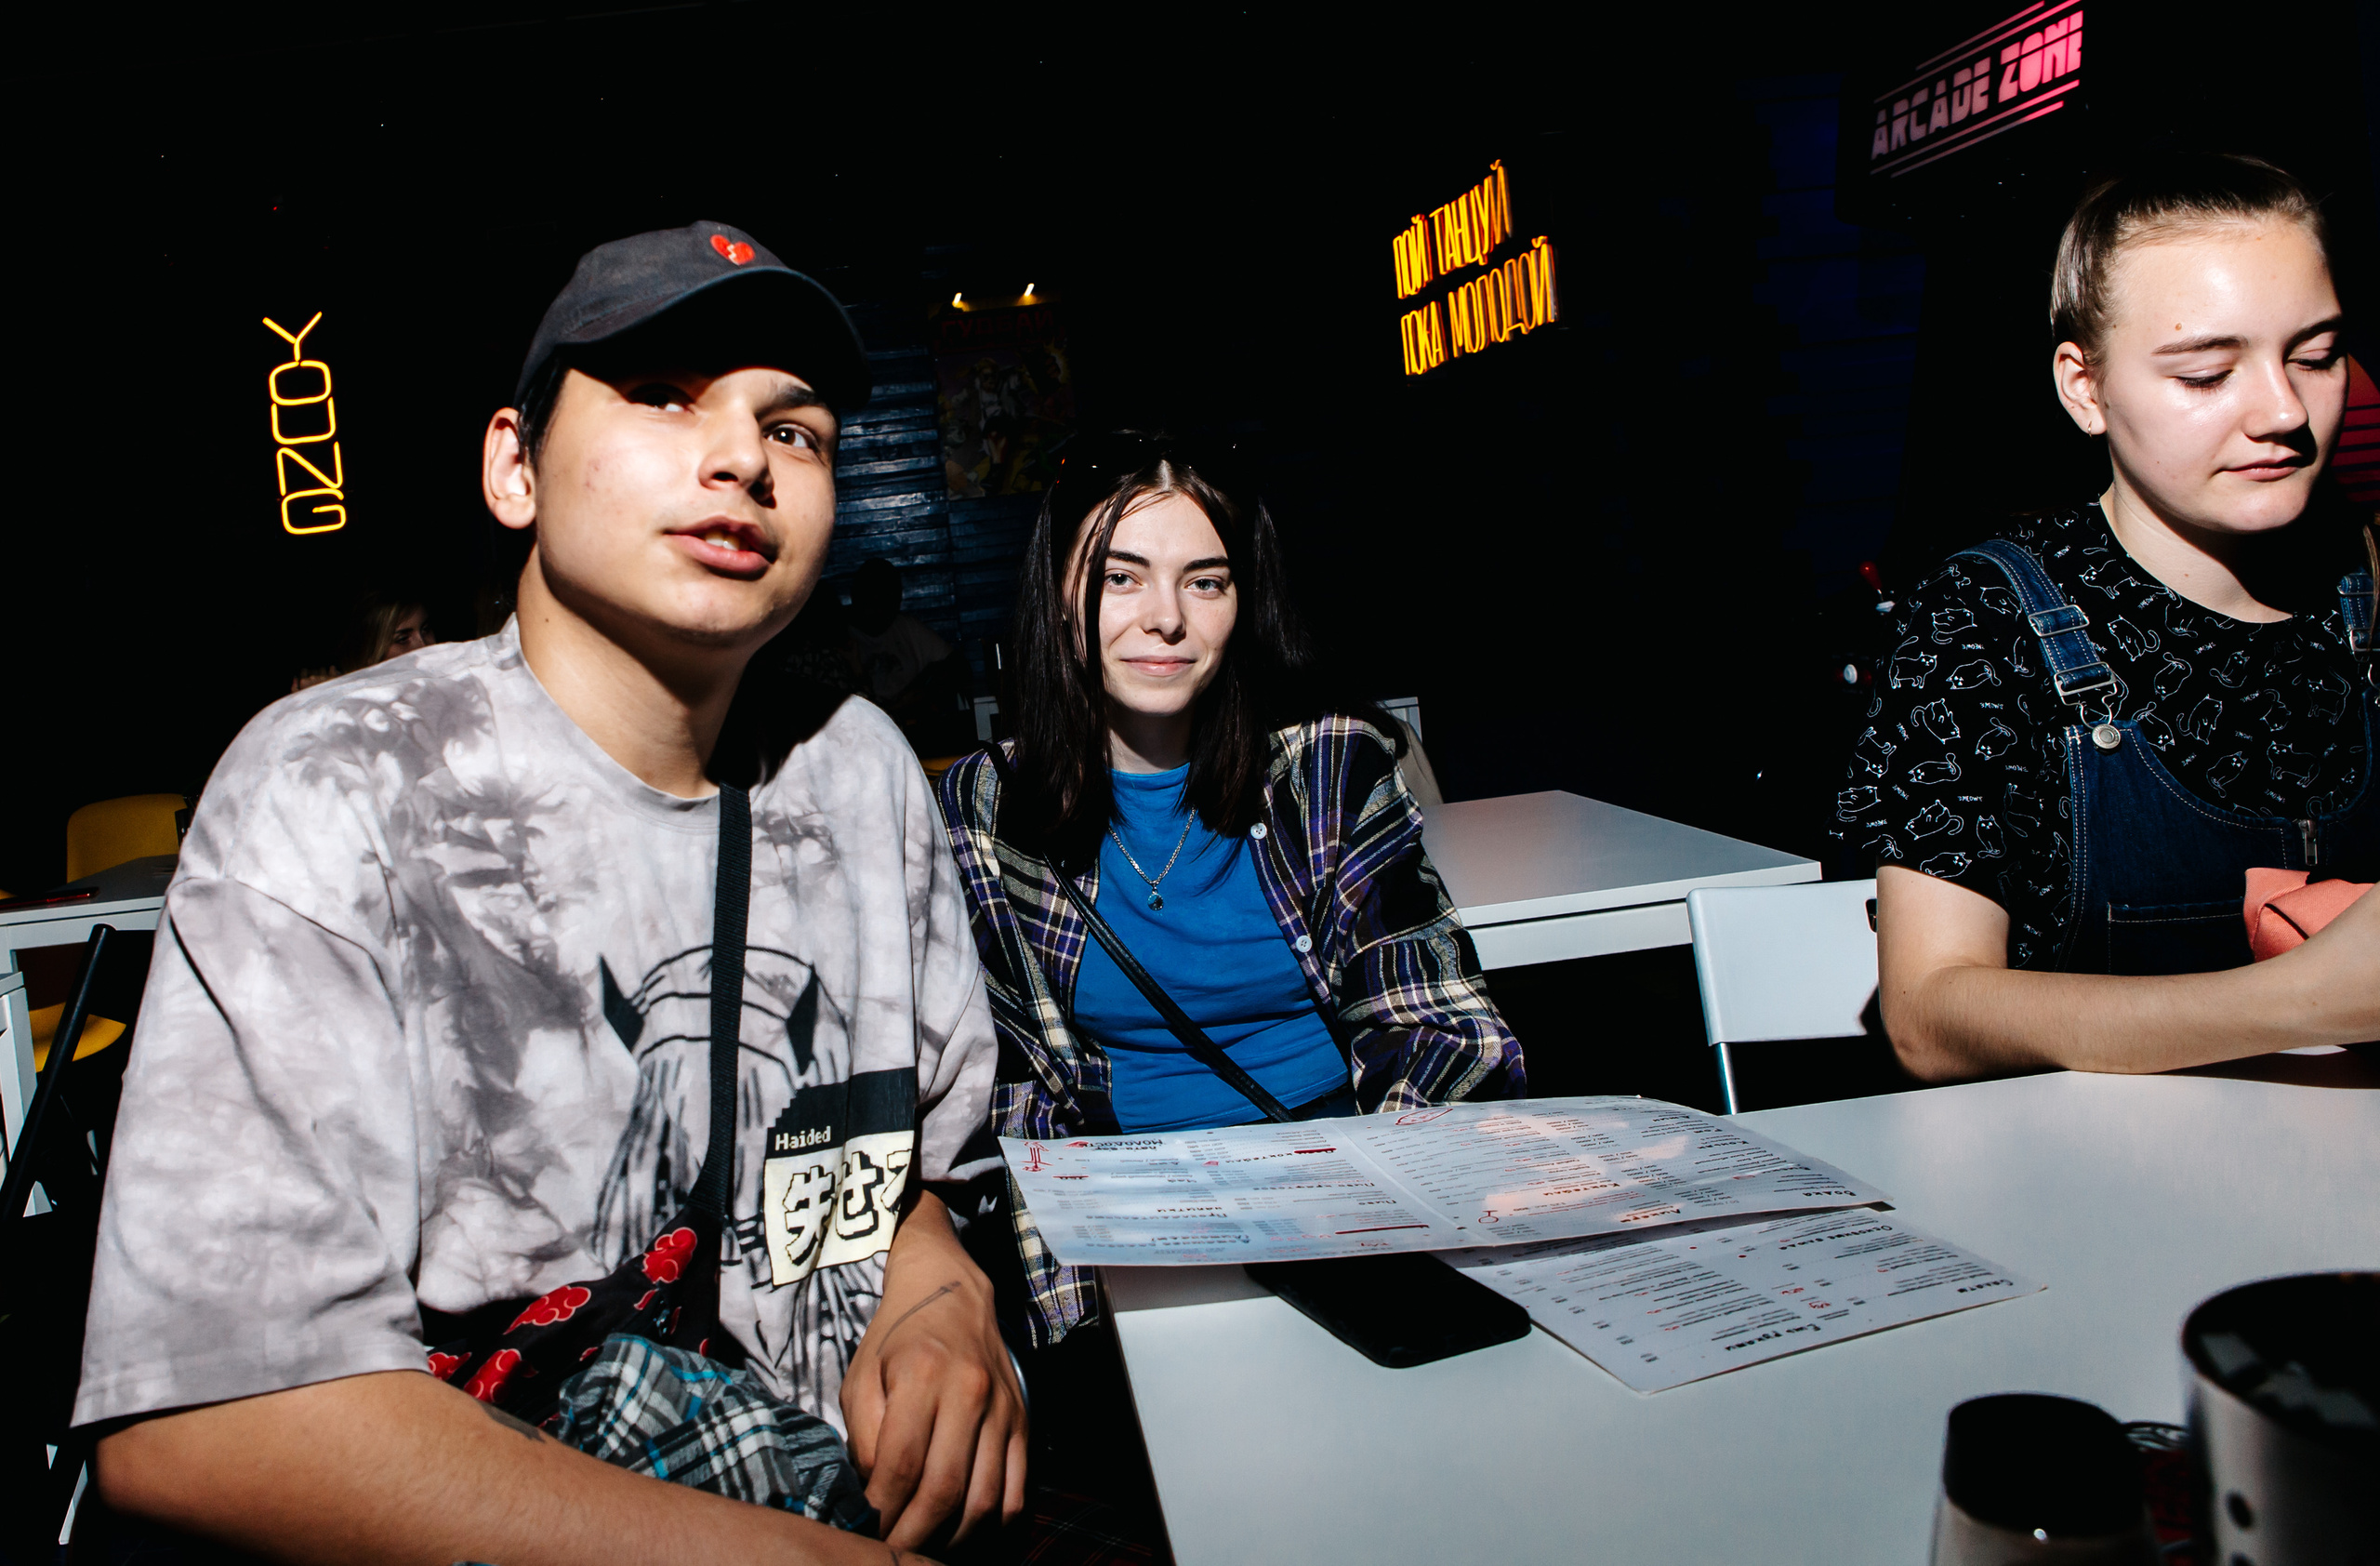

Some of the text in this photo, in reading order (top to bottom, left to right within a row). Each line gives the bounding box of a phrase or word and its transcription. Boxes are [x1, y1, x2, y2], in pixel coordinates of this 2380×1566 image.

[1871, 9, 2083, 160] ARCADE ZONE
[1393, 159, 1513, 299] ПОЙ ТАНЦУЙ
[1401, 235, 1558, 376] ПОКА МОЛОДОЙ
[262, 311, 347, 535] YOUNG
[774, 1126, 831, 1151] Haided
[1542, 1182, 1620, 1197] Коктейли
[1778, 1226, 1893, 1251] Основные блюда
[1957, 1280, 2014, 1294] Салаты
[1785, 1323, 1821, 1334] Ешь
